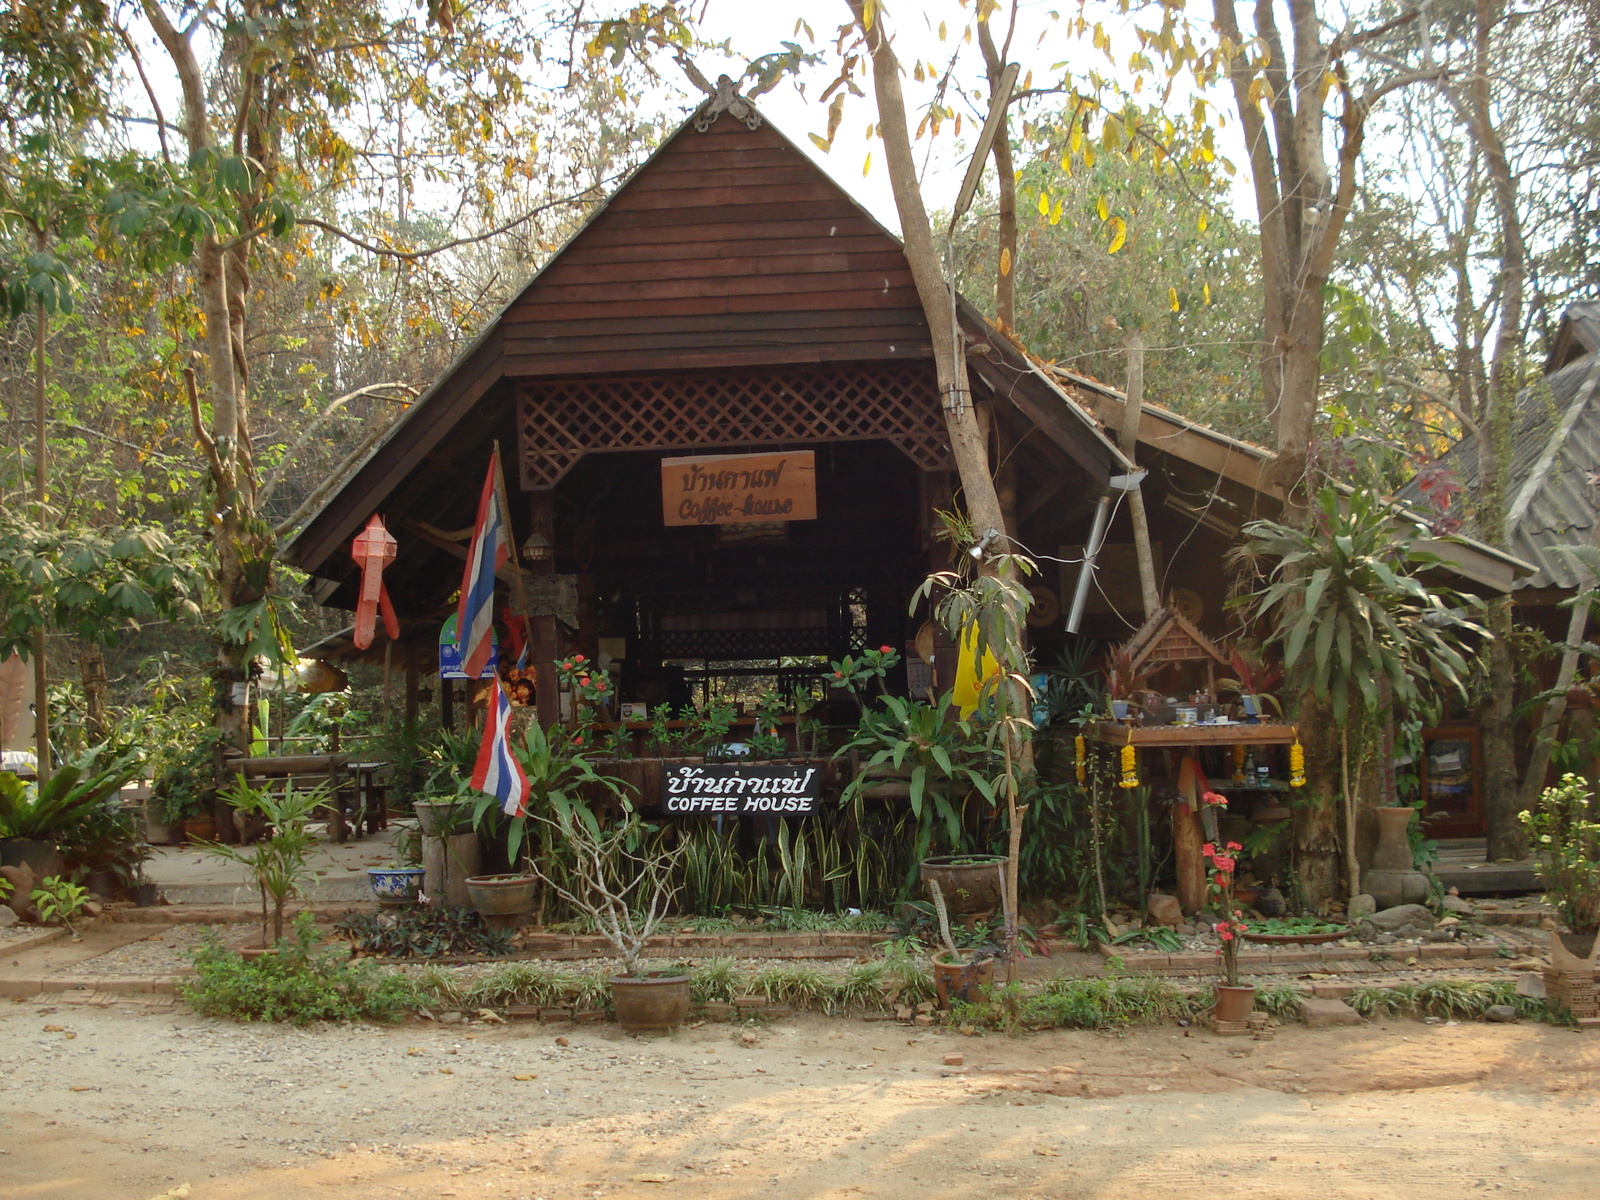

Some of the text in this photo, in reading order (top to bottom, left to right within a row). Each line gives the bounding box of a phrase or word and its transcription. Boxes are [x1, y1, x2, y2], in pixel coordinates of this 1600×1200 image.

[682, 459, 787, 492] บ้านกาแฟ
[667, 766, 817, 794] บ้านกาแฟ
[667, 796, 814, 812] COFFEE HOUSE
